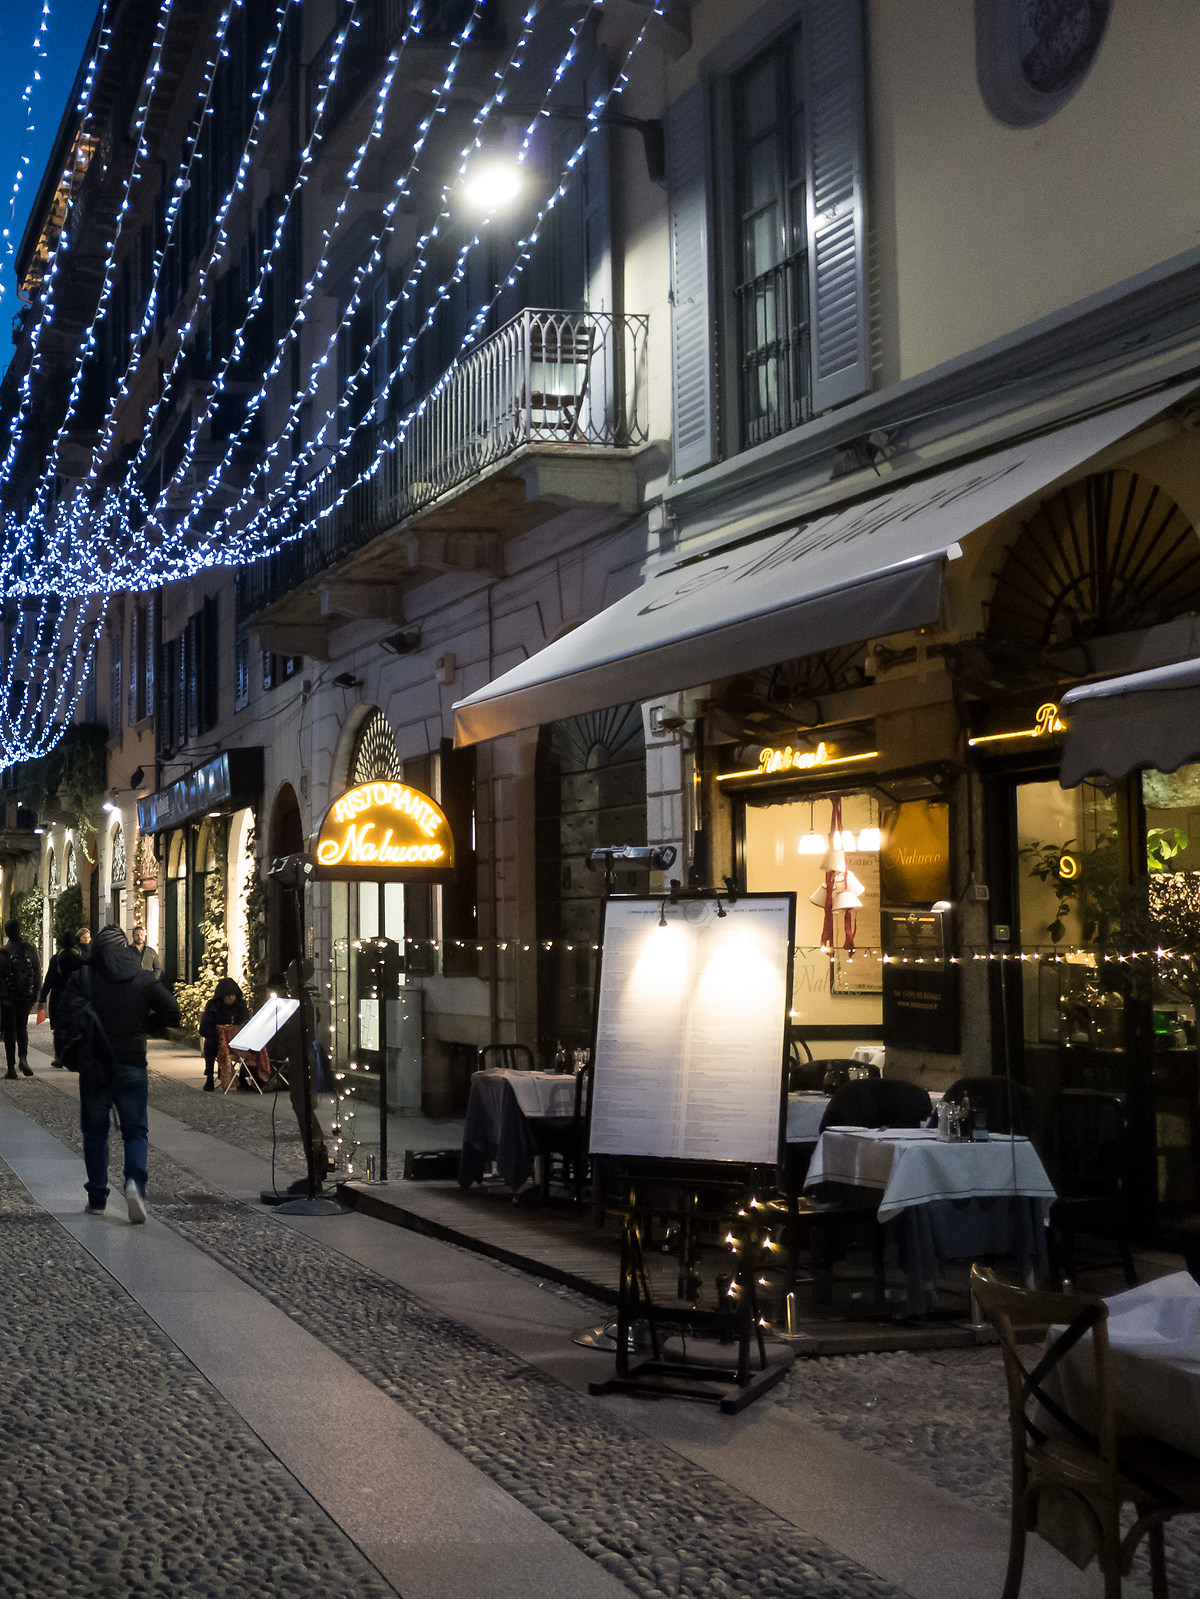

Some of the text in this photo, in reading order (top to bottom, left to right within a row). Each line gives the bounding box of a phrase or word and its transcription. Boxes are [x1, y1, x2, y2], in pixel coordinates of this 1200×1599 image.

[335, 782, 443, 838] RISTORANTE
[317, 823, 444, 865] Nabucco
[890, 847, 941, 866] Nabucco
